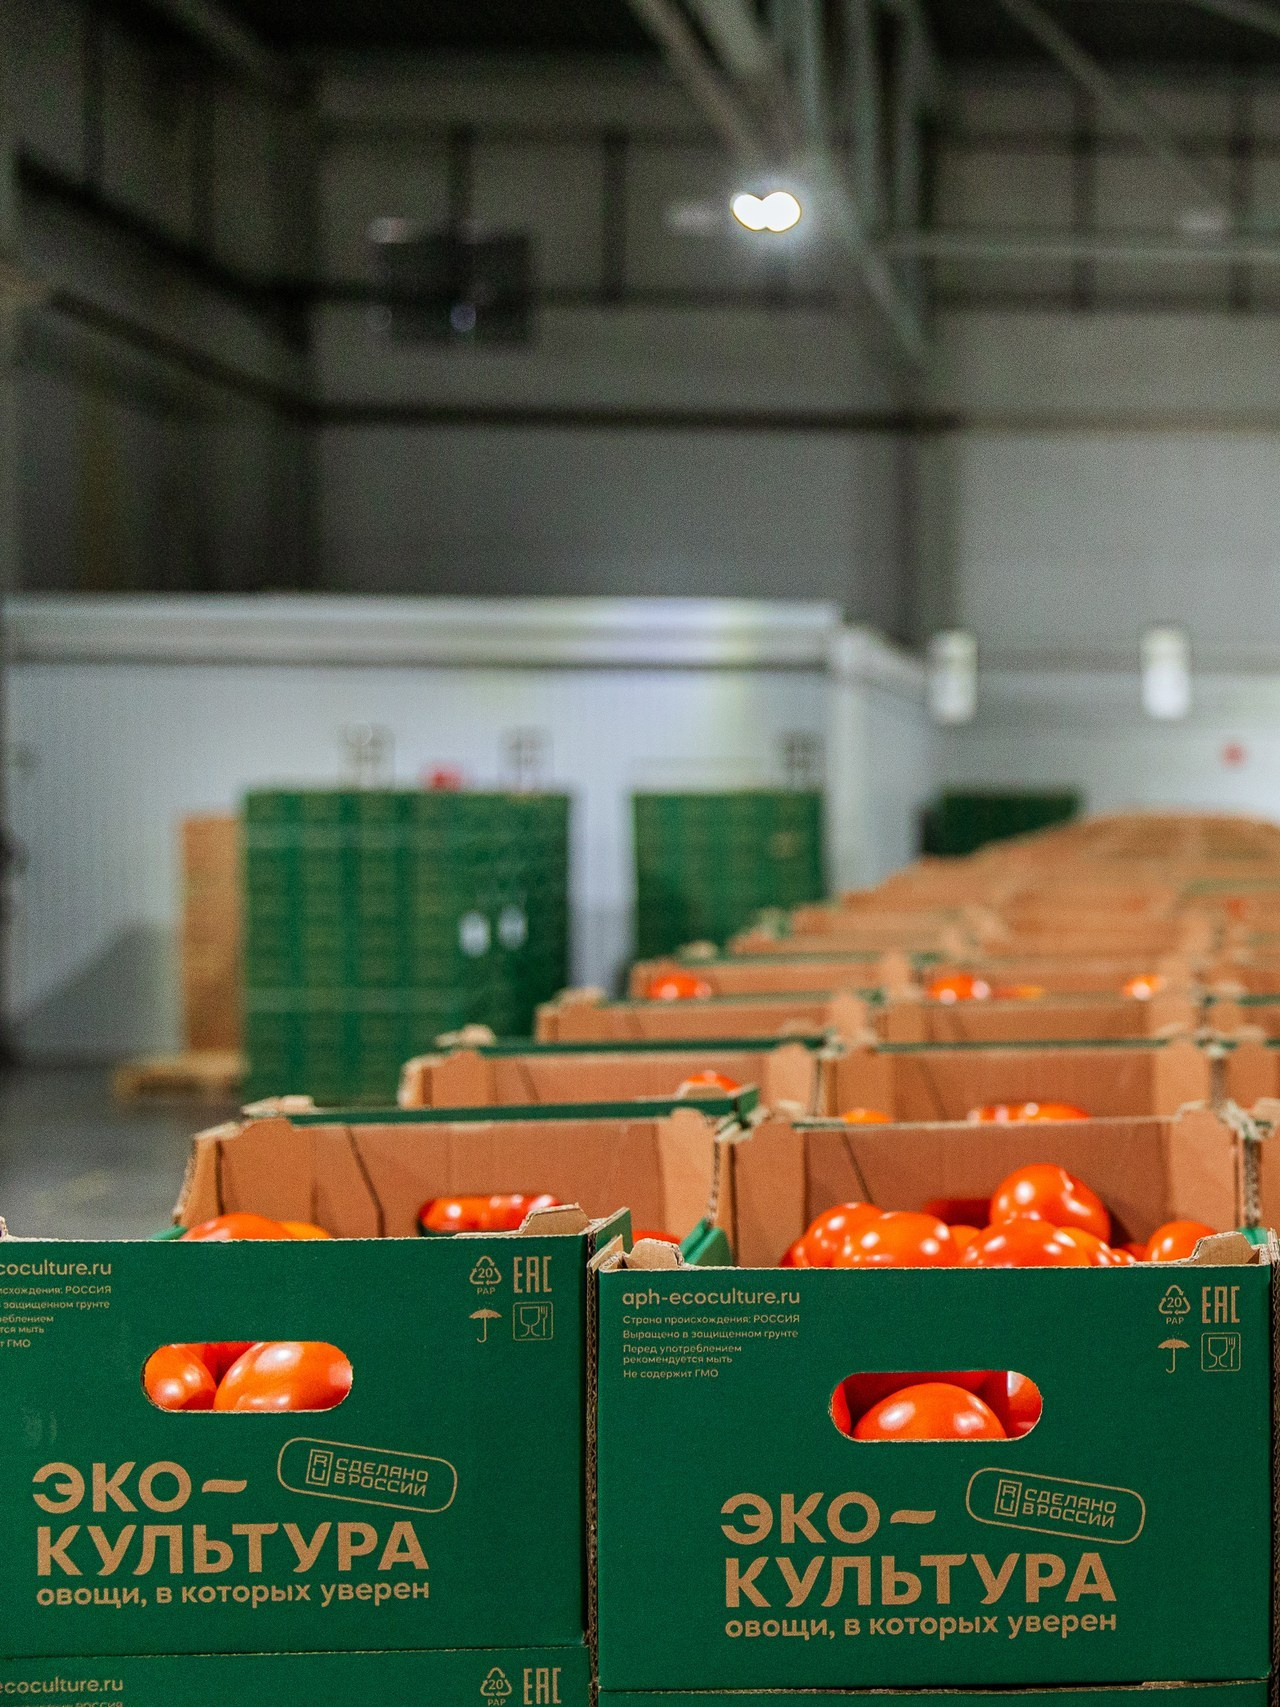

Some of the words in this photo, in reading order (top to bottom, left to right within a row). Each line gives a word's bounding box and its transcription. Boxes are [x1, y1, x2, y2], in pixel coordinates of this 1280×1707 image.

[478, 1268, 493, 1278] 20
[65, 1285, 111, 1294] РОССИЯ
[477, 1286, 495, 1295] PAP
[622, 1288, 800, 1309] aph-ecoculture.ru
[1167, 1297, 1182, 1308] 20
[76, 1301, 110, 1310] грунте
[623, 1315, 662, 1326] Страна
[664, 1316, 751, 1325] происхождения:
[753, 1314, 800, 1323] РОССИЯ
[1166, 1316, 1184, 1325] PAP
[623, 1330, 680, 1340] Выращено
[692, 1330, 762, 1339] защищенном
[764, 1331, 798, 1340] грунте
[7, 1339, 31, 1348] ГМО
[623, 1344, 657, 1354] Перед
[660, 1344, 742, 1354] употреблением
[623, 1356, 704, 1365] рекомендуется
[706, 1355, 732, 1364] мыть
[623, 1370, 637, 1379] Не
[640, 1371, 692, 1380] содержит
[695, 1369, 718, 1378] ГМО
[336, 1458, 428, 1482] СДЕЛАНО
[1025, 1489, 1116, 1513] СДЕЛАНО
[37, 1521, 429, 1576] КУЛЬТУРА
[726, 1553, 1116, 1607] КУЛЬТУРА
[36, 1587, 147, 1609] овощи,
[156, 1587, 172, 1603] в
[182, 1585, 310, 1608] которых
[321, 1582, 429, 1607] уверен
[725, 1619, 835, 1640] овощи,
[844, 1619, 860, 1635] в
[870, 1616, 998, 1641] которых
[1008, 1614, 1116, 1639] уверен
[0, 1676, 123, 1694] coculture.ru
[488, 1680, 504, 1690] 20
[488, 1698, 506, 1706] PAP
